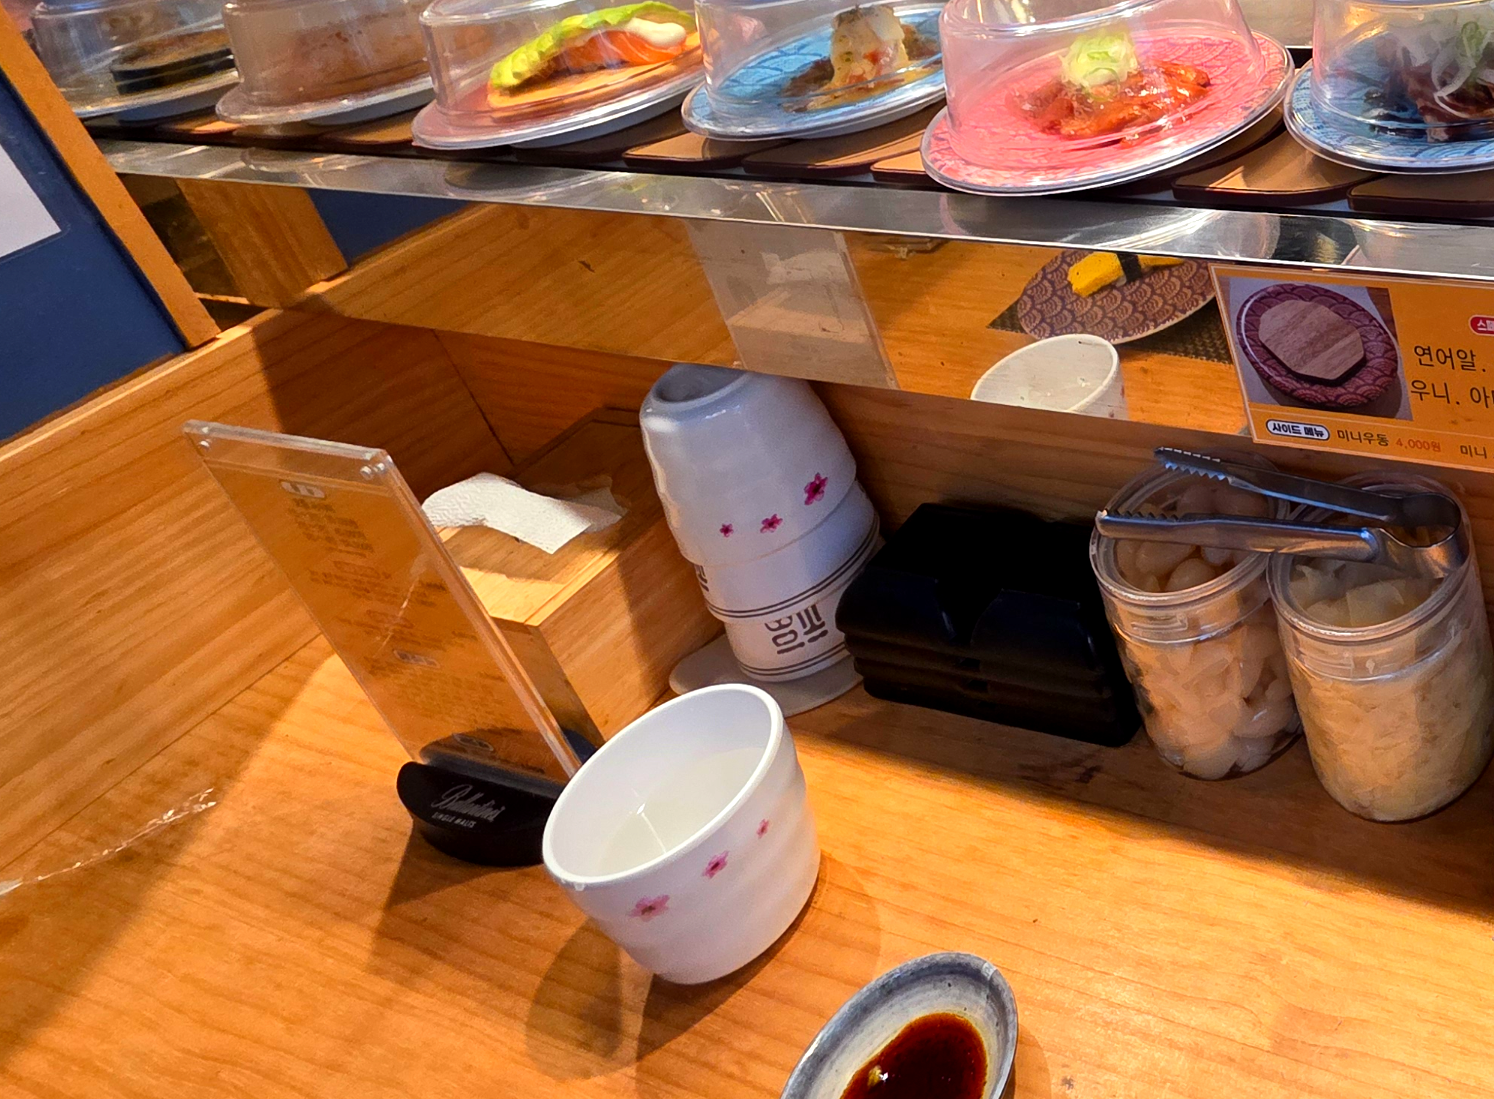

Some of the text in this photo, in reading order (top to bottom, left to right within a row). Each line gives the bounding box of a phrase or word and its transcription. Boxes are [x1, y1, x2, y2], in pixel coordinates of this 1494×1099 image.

[1272, 422, 1325, 438] 사이드 메뉴
[1337, 429, 1389, 447] 미니우동
[1460, 444, 1487, 459] 미니
